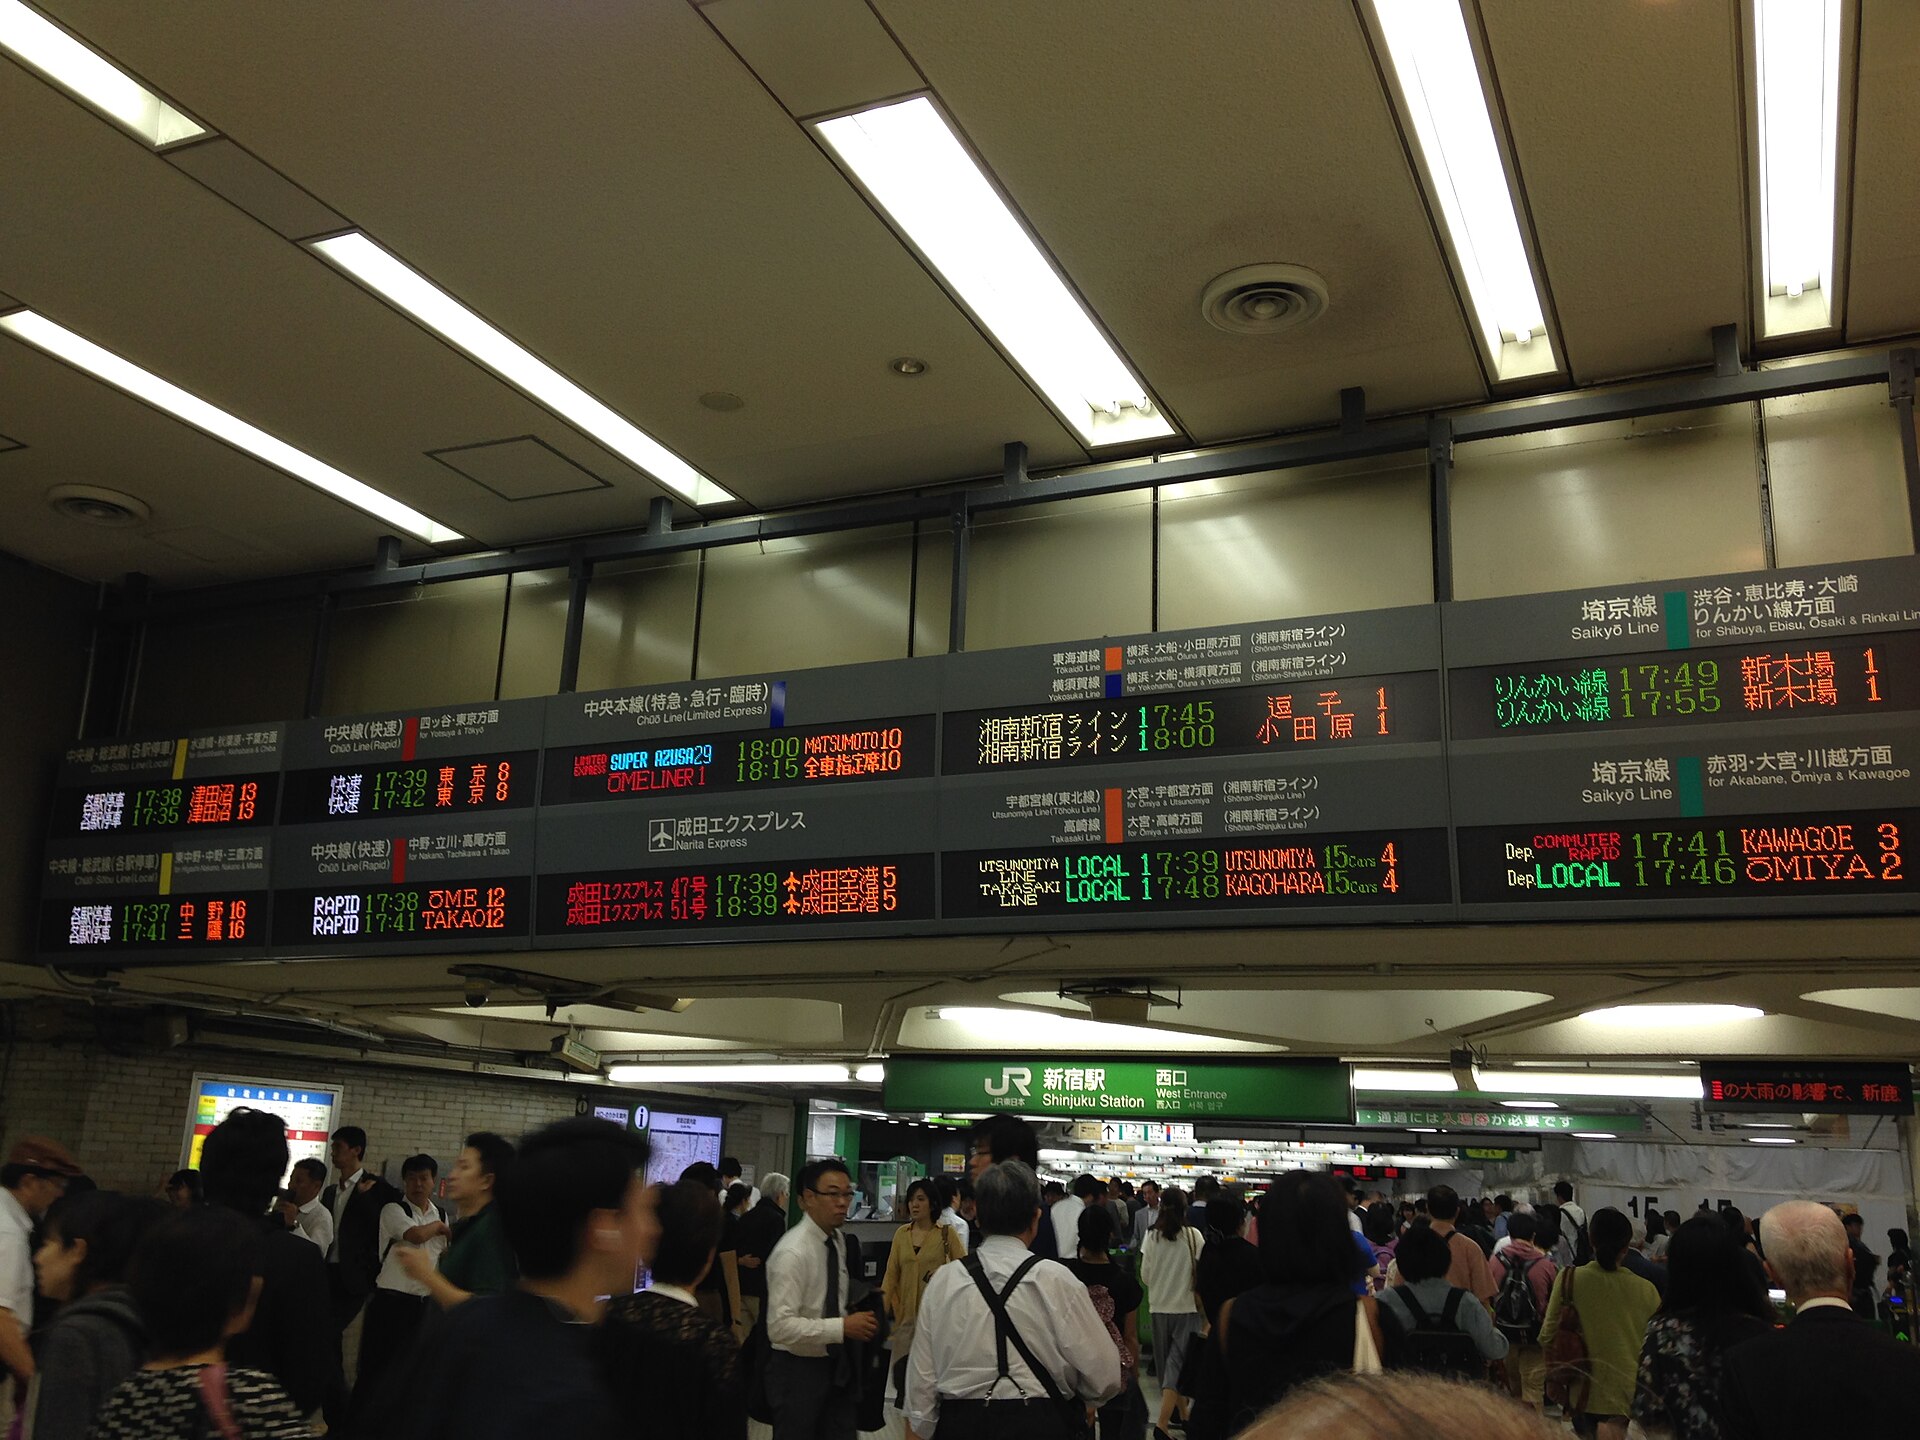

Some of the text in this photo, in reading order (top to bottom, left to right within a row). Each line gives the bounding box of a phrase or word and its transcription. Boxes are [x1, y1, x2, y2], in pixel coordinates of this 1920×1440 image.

[1693, 574, 1858, 607] 渋谷・恵比寿・大崎
[1582, 594, 1658, 622] 埼京線
[1694, 596, 1835, 626] りんかい線方面
[1571, 619, 1660, 640] Saikyō Line
[1716, 610, 1900, 638] Shibuya, Ebisu, Ōsaki Rinkai
[1126, 623, 1347, 658] 横浜・大船・小田原方面 (湘南新宿ライン)
[1138, 638, 1333, 665] Yokohama, Ōdawara Line)
[1052, 650, 1100, 666] 東海道線
[1055, 663, 1101, 675] Tōkaidō Line
[1126, 651, 1347, 684] 横浜・大船・横須賀方面 (湘南新宿ライン)
[1052, 677, 1100, 693] 横須賀線
[1138, 666, 1334, 692] Yokohama, Yokosuka Line)
[1495, 648, 1878, 703] りんかい線 17:49 新木場 1
[584, 682, 769, 718] 中央本線(特急・急行・臨時)
[724, 702, 768, 718] Express)
[1048, 690, 1101, 703] Yokosuka Line
[1497, 675, 1882, 728] りんかい線 17:55 新木場 1
[979, 710, 1128, 744] 湘南新宿ライン
[1138, 701, 1215, 729] 17:45
[1376, 687, 1388, 710] 1
[324, 718, 403, 742] 中央線(快速)
[978, 711, 1389, 764] 湘南新宿ライン 18:00 1
[574, 753, 607, 767] LIMITED
[610, 751, 648, 771] SUPER
[738, 736, 800, 761] 18:00
[736, 752, 880, 782] 18:15 全車指定席
[1592, 745, 1893, 785] 埼京線 赤羽・大宮・川越方面
[330, 773, 363, 796] 快速
[374, 769, 428, 792] 17:39
[498, 762, 510, 781] 8
[1006, 776, 1320, 809] 宇都宮線(東北線) 大宮・宇都宮方面 (湘南新宿ライン)
[1582, 767, 1911, 806] Saikyō Line Akabane, Ōmiya Kawagoe
[189, 783, 234, 806] 津田沼
[240, 782, 257, 801] 13
[328, 792, 361, 815] 快速
[372, 788, 426, 810] 17:42
[496, 782, 509, 801] 8
[992, 795, 1210, 820] Utsunomiya Utsunomiya
[187, 802, 232, 825] 津田沼
[236, 801, 255, 820] 13
[676, 810, 806, 837] 成田エクスプレス
[1064, 806, 1320, 833] 高崎線 大宮・高崎方面 (湘南新宿ライン)
[311, 831, 507, 861] 中央線(快速) 中野・立川・高尾方面
[676, 837, 747, 851] Narita Express
[1050, 825, 1202, 845] Takasaki Line Takasaki
[1533, 832, 1621, 849] COMMUTER
[1568, 846, 1621, 861] RAPID
[1632, 829, 1732, 859] 17:41
[1741, 824, 1854, 855] KAWAGOE
[1877, 823, 1900, 850] 3
[979, 842, 1397, 879] UTSUNOMIYA LOCAL 17:39 UTSUNOMIYA 4
[1535, 853, 1903, 889] LOCAL 17:46 ŌMIYA 2
[715, 872, 778, 896] 17:39
[800, 866, 879, 893] 成田空港
[883, 866, 896, 889] 5
[979, 868, 1399, 903] TAKASAKI LOCAL 17:48 KAGOHARA 4
[1000, 870, 1036, 884] LINE
[122, 903, 170, 923] 17:37
[228, 900, 246, 920] 16
[313, 887, 506, 916] RAPID 17:38 ŌME 12
[715, 894, 778, 918] 18:39
[800, 888, 879, 915] 成田空港
[883, 888, 897, 911] 5
[1000, 894, 1038, 907] LINE
[121, 922, 167, 941] 17:41
[227, 919, 245, 939] 16
[313, 908, 505, 936] RAPID 17:41 TAKAO 12
[984, 1067, 1032, 1097] JR
[1044, 1068, 1187, 1091] 新宿駅 西口
[1042, 1088, 1227, 1110] Shinjuku Station West Entrance
[1156, 1100, 1181, 1110] 西入口
